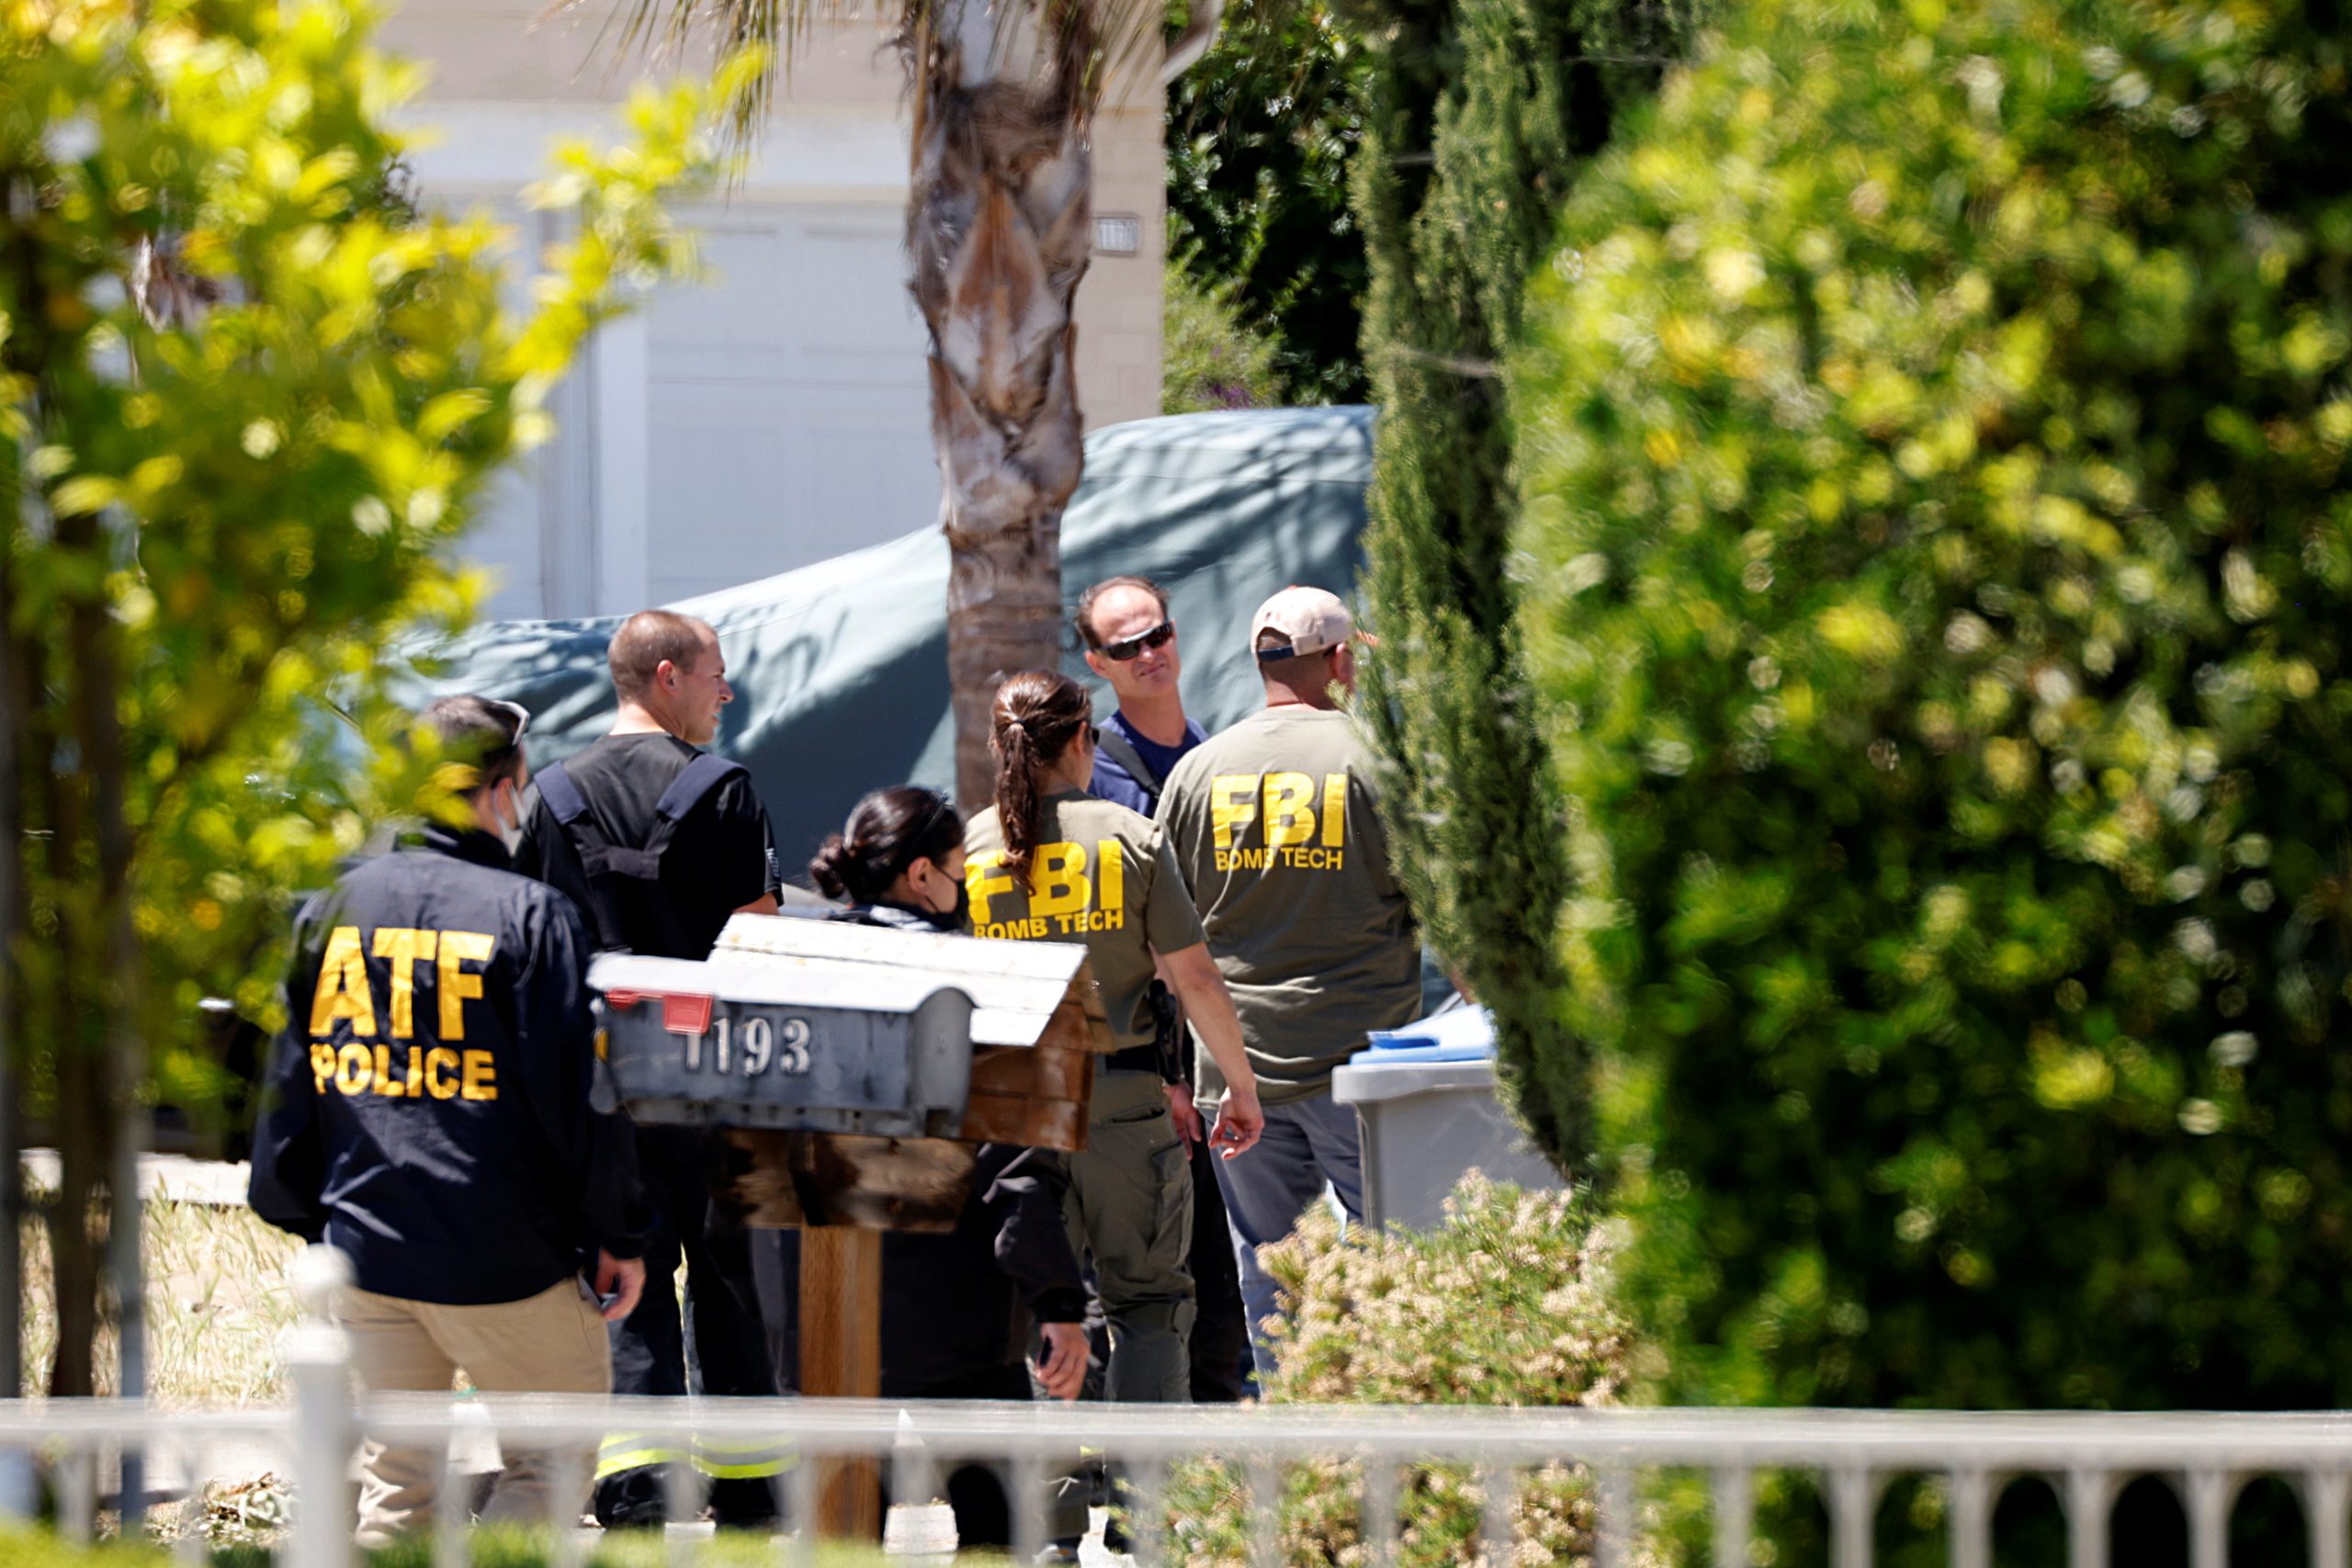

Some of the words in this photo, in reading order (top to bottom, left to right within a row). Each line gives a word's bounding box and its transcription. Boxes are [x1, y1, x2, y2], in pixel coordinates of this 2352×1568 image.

[1211, 772, 1347, 849] FBI
[964, 839, 1124, 924] FBI
[1215, 847, 1275, 872] BOMB
[1281, 847, 1343, 870] TECH
[973, 917, 1048, 940] BOMB
[1055, 909, 1124, 934] TECH
[309, 926, 494, 1041] ATF
[310, 1043, 497, 1100] POLICE
[685, 1017, 811, 1076] 1193
